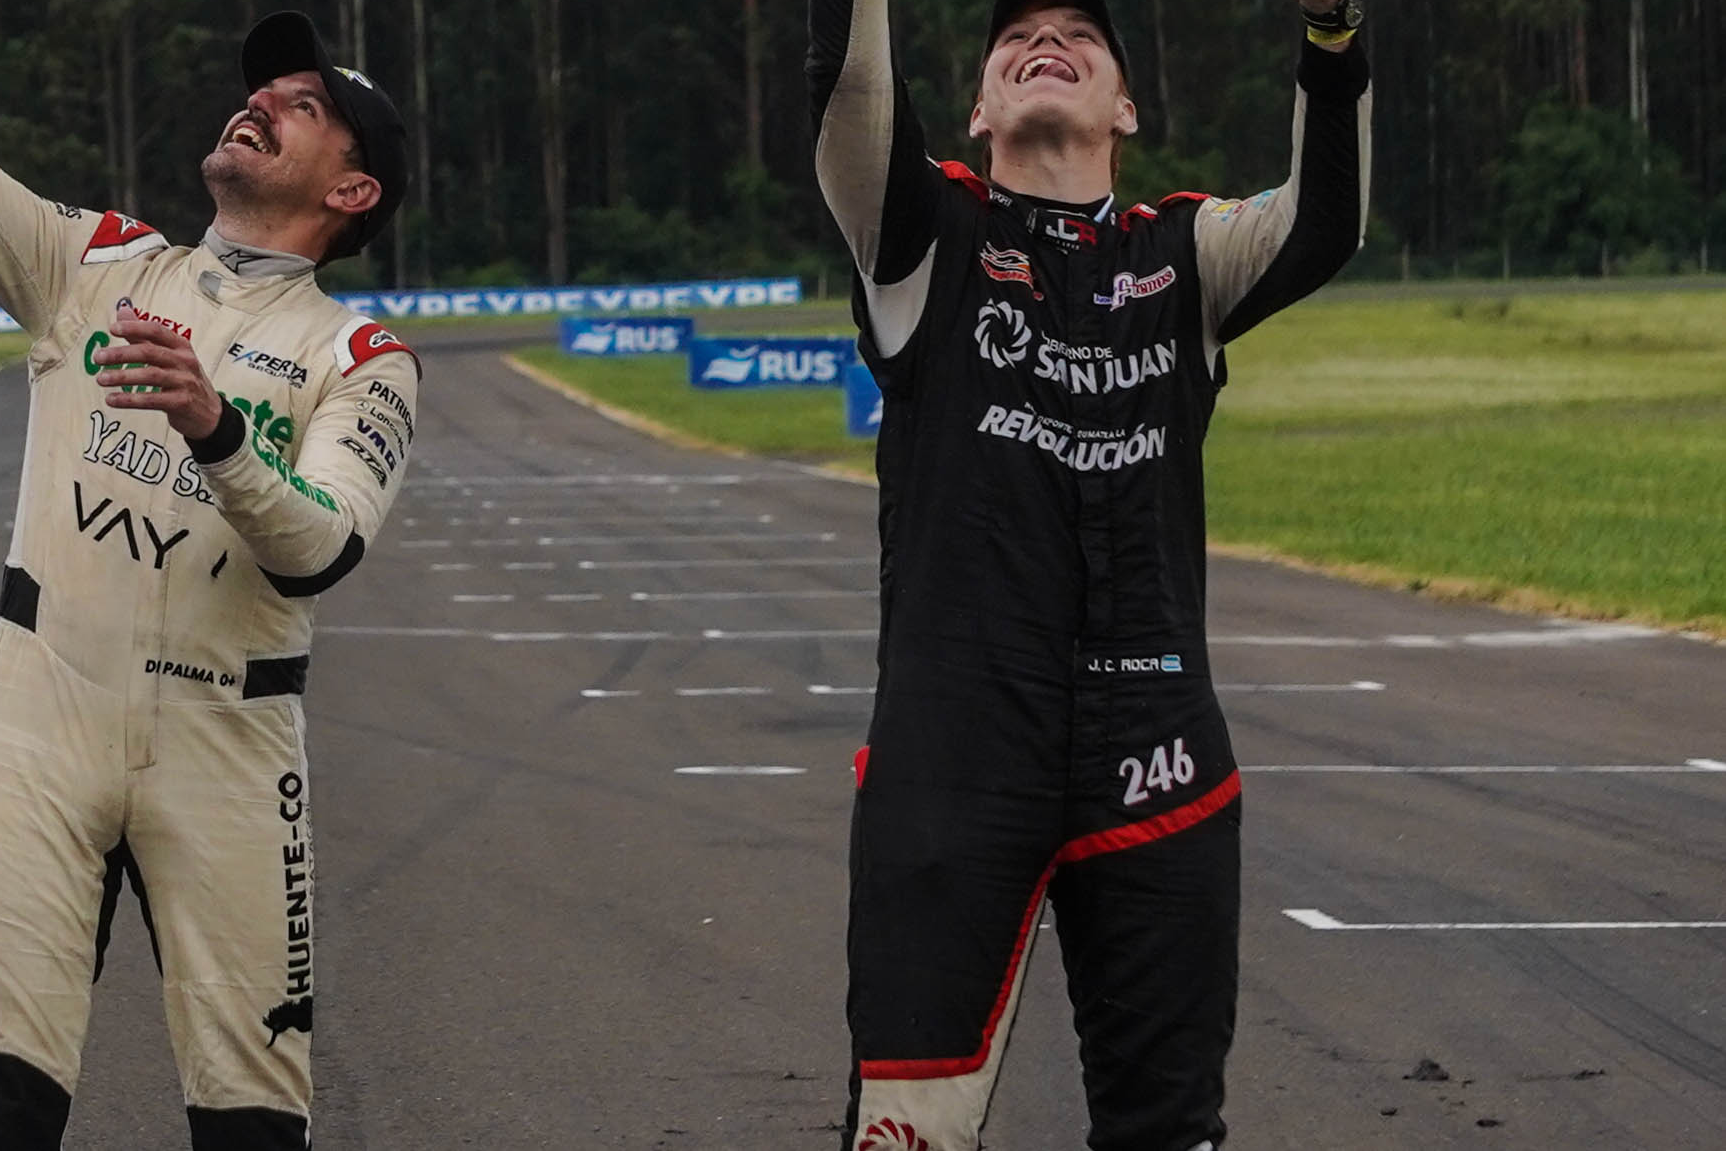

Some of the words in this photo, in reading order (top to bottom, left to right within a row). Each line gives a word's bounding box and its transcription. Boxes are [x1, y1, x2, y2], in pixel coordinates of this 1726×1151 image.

[615, 326, 679, 352] RUS
[1094, 346, 1114, 359] DE
[758, 350, 838, 381] RUS
[1034, 344, 1098, 395] SAN
[1102, 339, 1176, 394] JUAN
[82, 408, 171, 487] YAD
[162, 661, 214, 684] PALMA
[1121, 658, 1159, 672] ROCA
[1118, 737, 1196, 806] 246
[277, 772, 311, 995] HUENTE-CO
